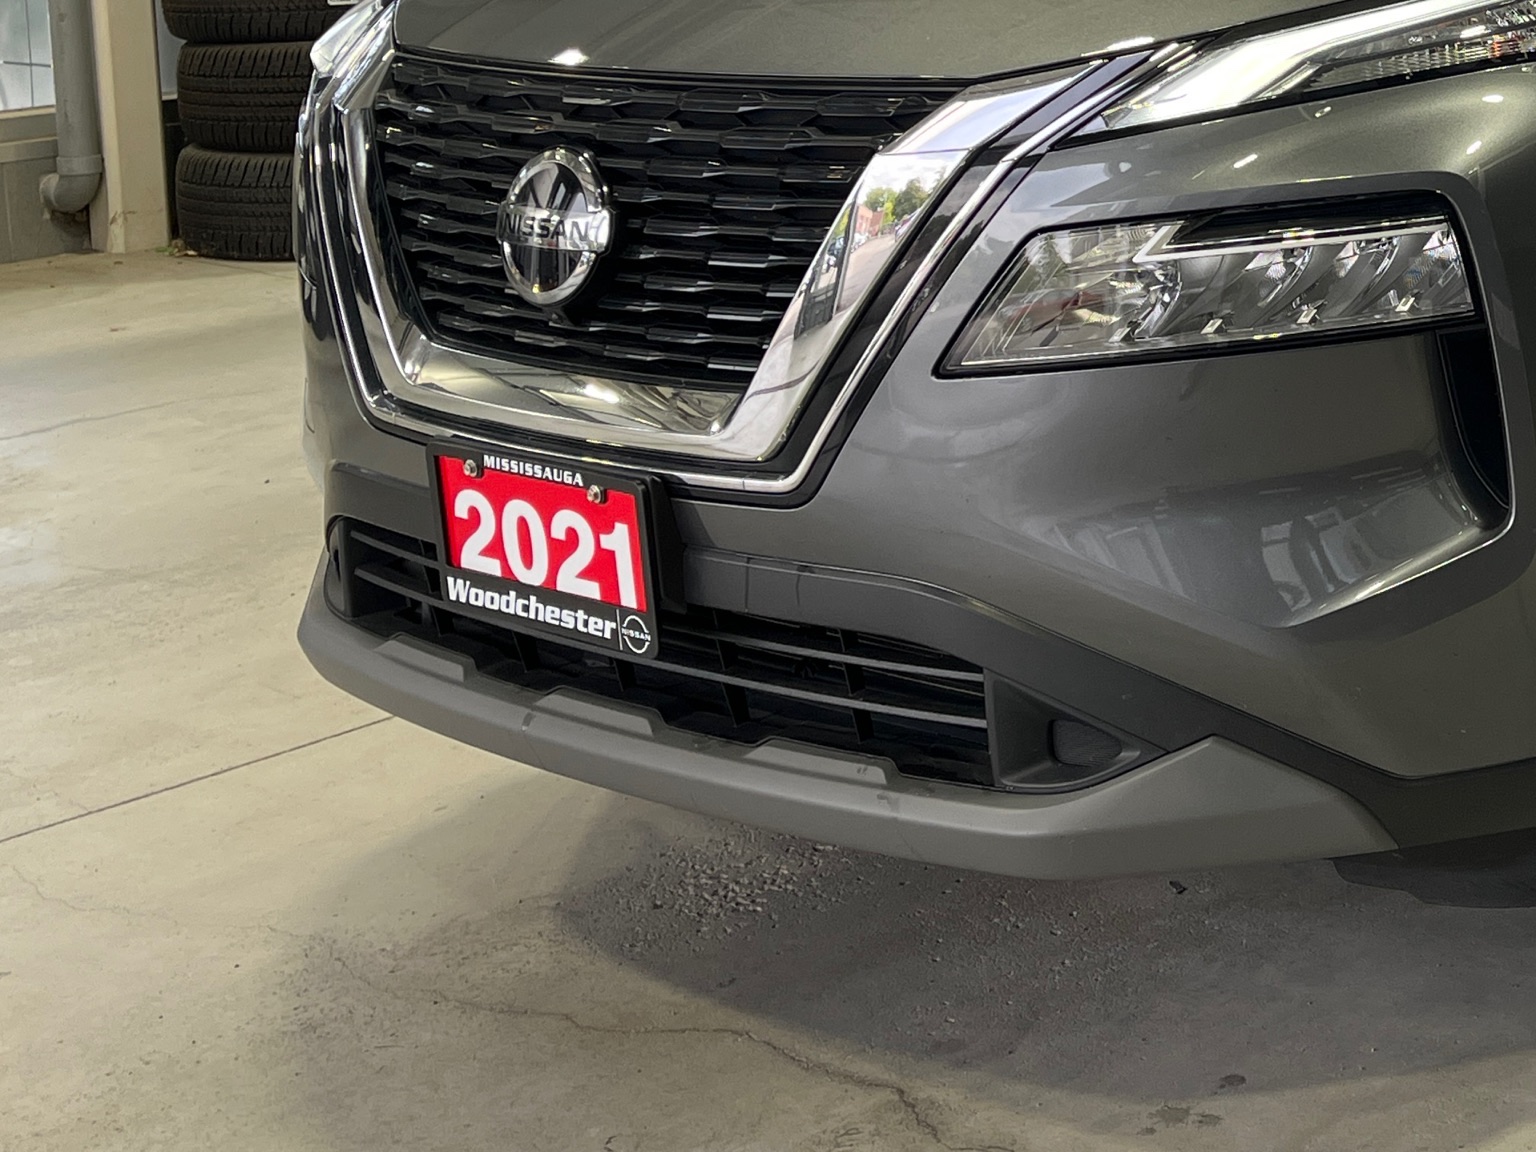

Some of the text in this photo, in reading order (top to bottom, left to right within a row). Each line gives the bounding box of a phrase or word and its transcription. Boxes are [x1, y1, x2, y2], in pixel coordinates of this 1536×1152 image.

[503, 213, 590, 242] NISSAN
[483, 454, 584, 487] MISSISSAUGA
[454, 489, 638, 609] 2021
[447, 576, 616, 639] Woodchester
